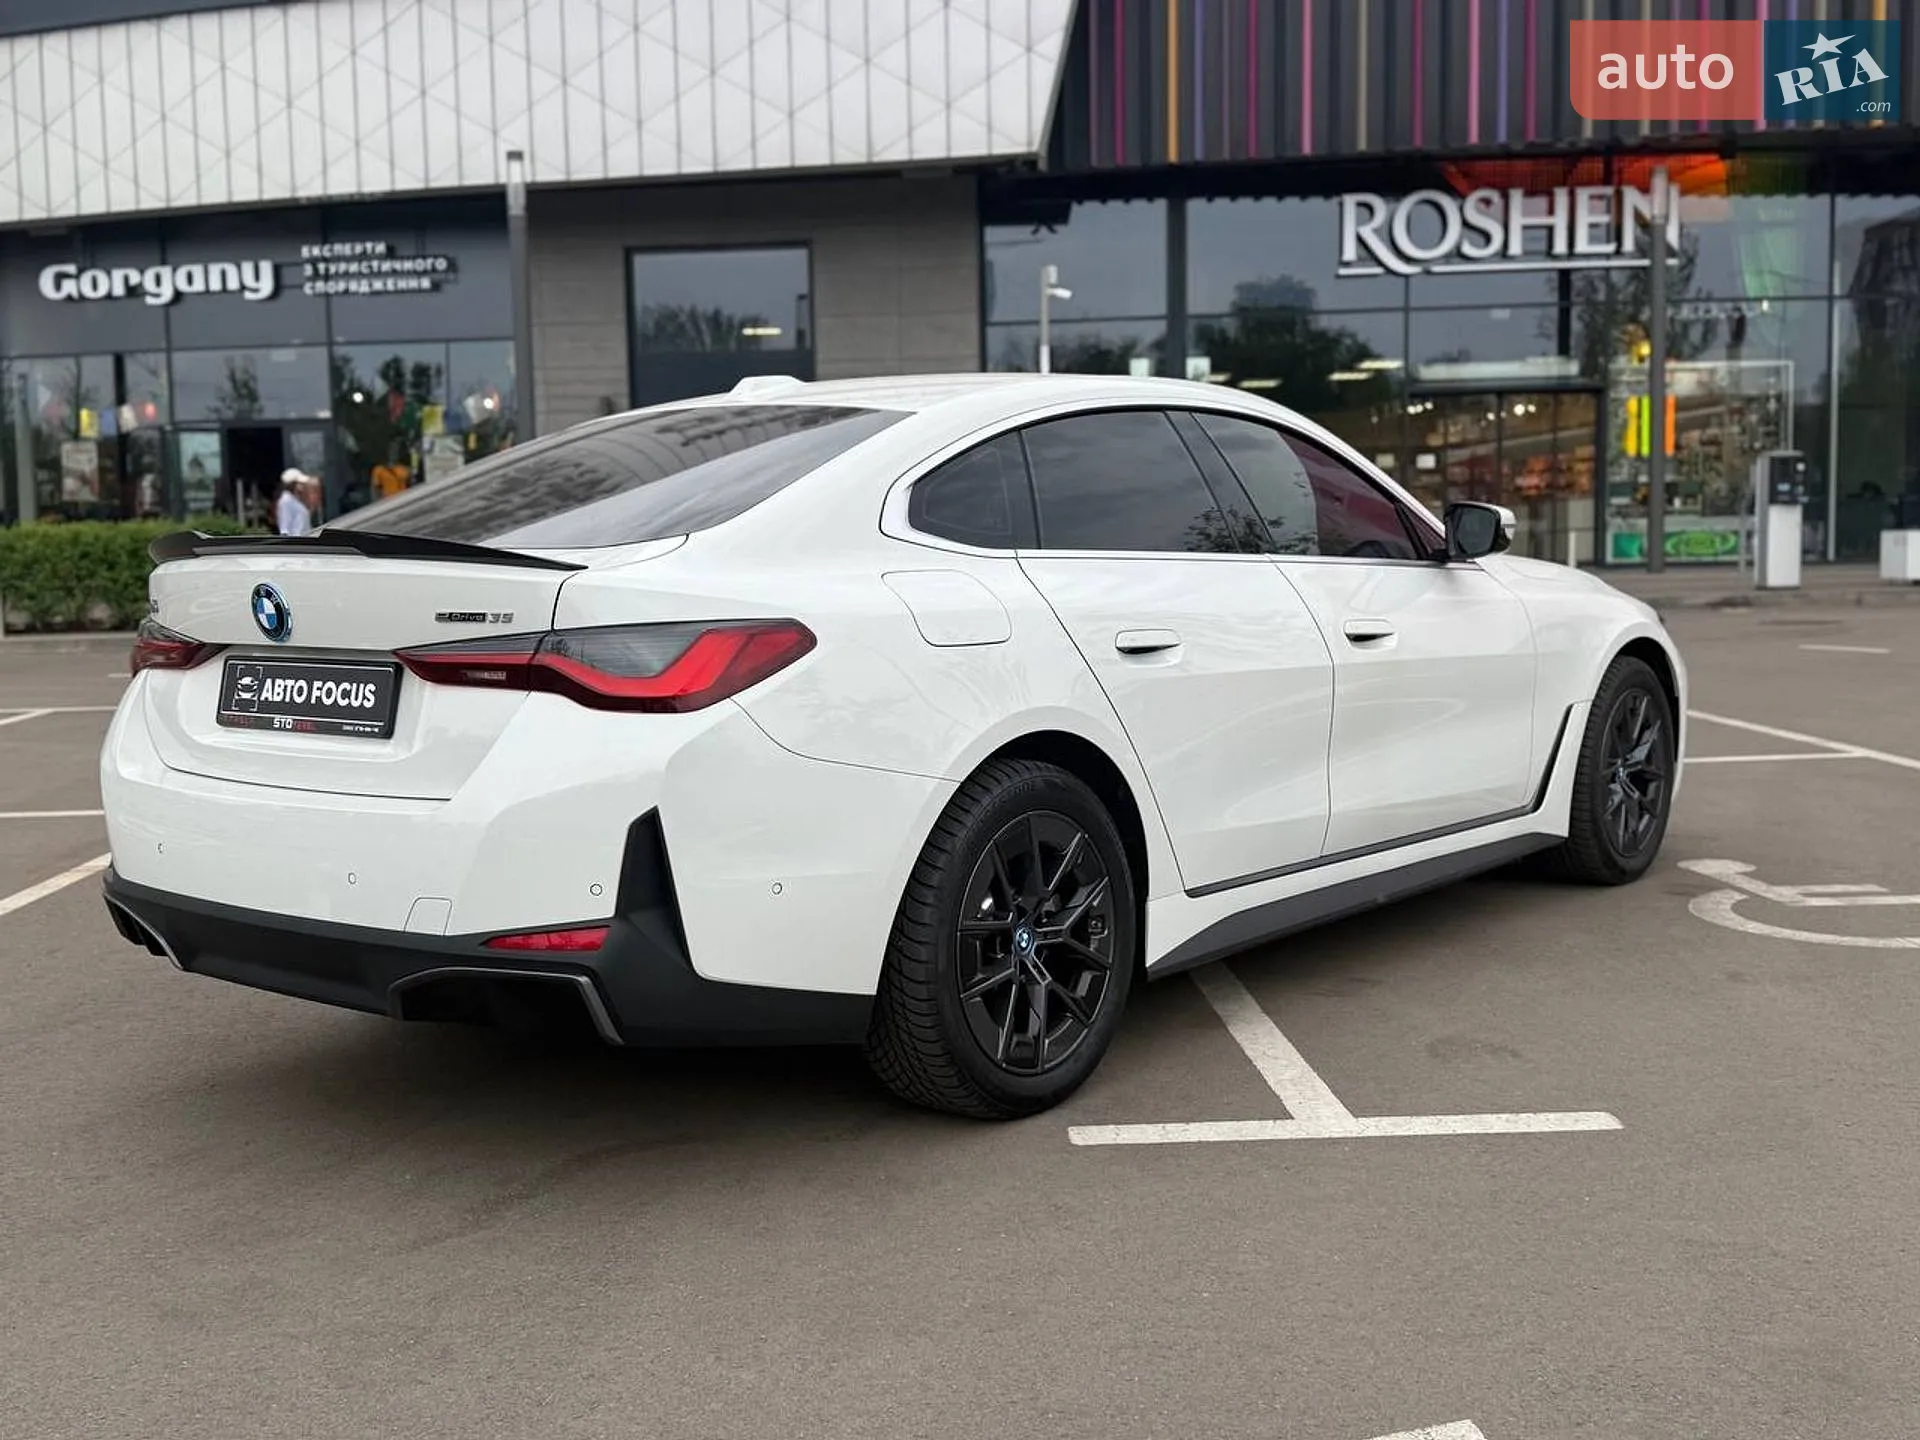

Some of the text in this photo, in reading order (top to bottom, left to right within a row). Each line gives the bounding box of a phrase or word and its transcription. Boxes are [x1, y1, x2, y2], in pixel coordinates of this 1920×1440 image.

[1338, 183, 1681, 275] ROSHEN
[301, 241, 386, 258] ЕКСПЕРТИ
[317, 257, 448, 275] ТУРИСТИЧНОГО
[38, 260, 276, 306] Gorgany
[303, 277, 431, 295] СПОРЯДЖЕННЯ
[488, 612, 514, 623] 35
[311, 680, 377, 708] FOCUS
